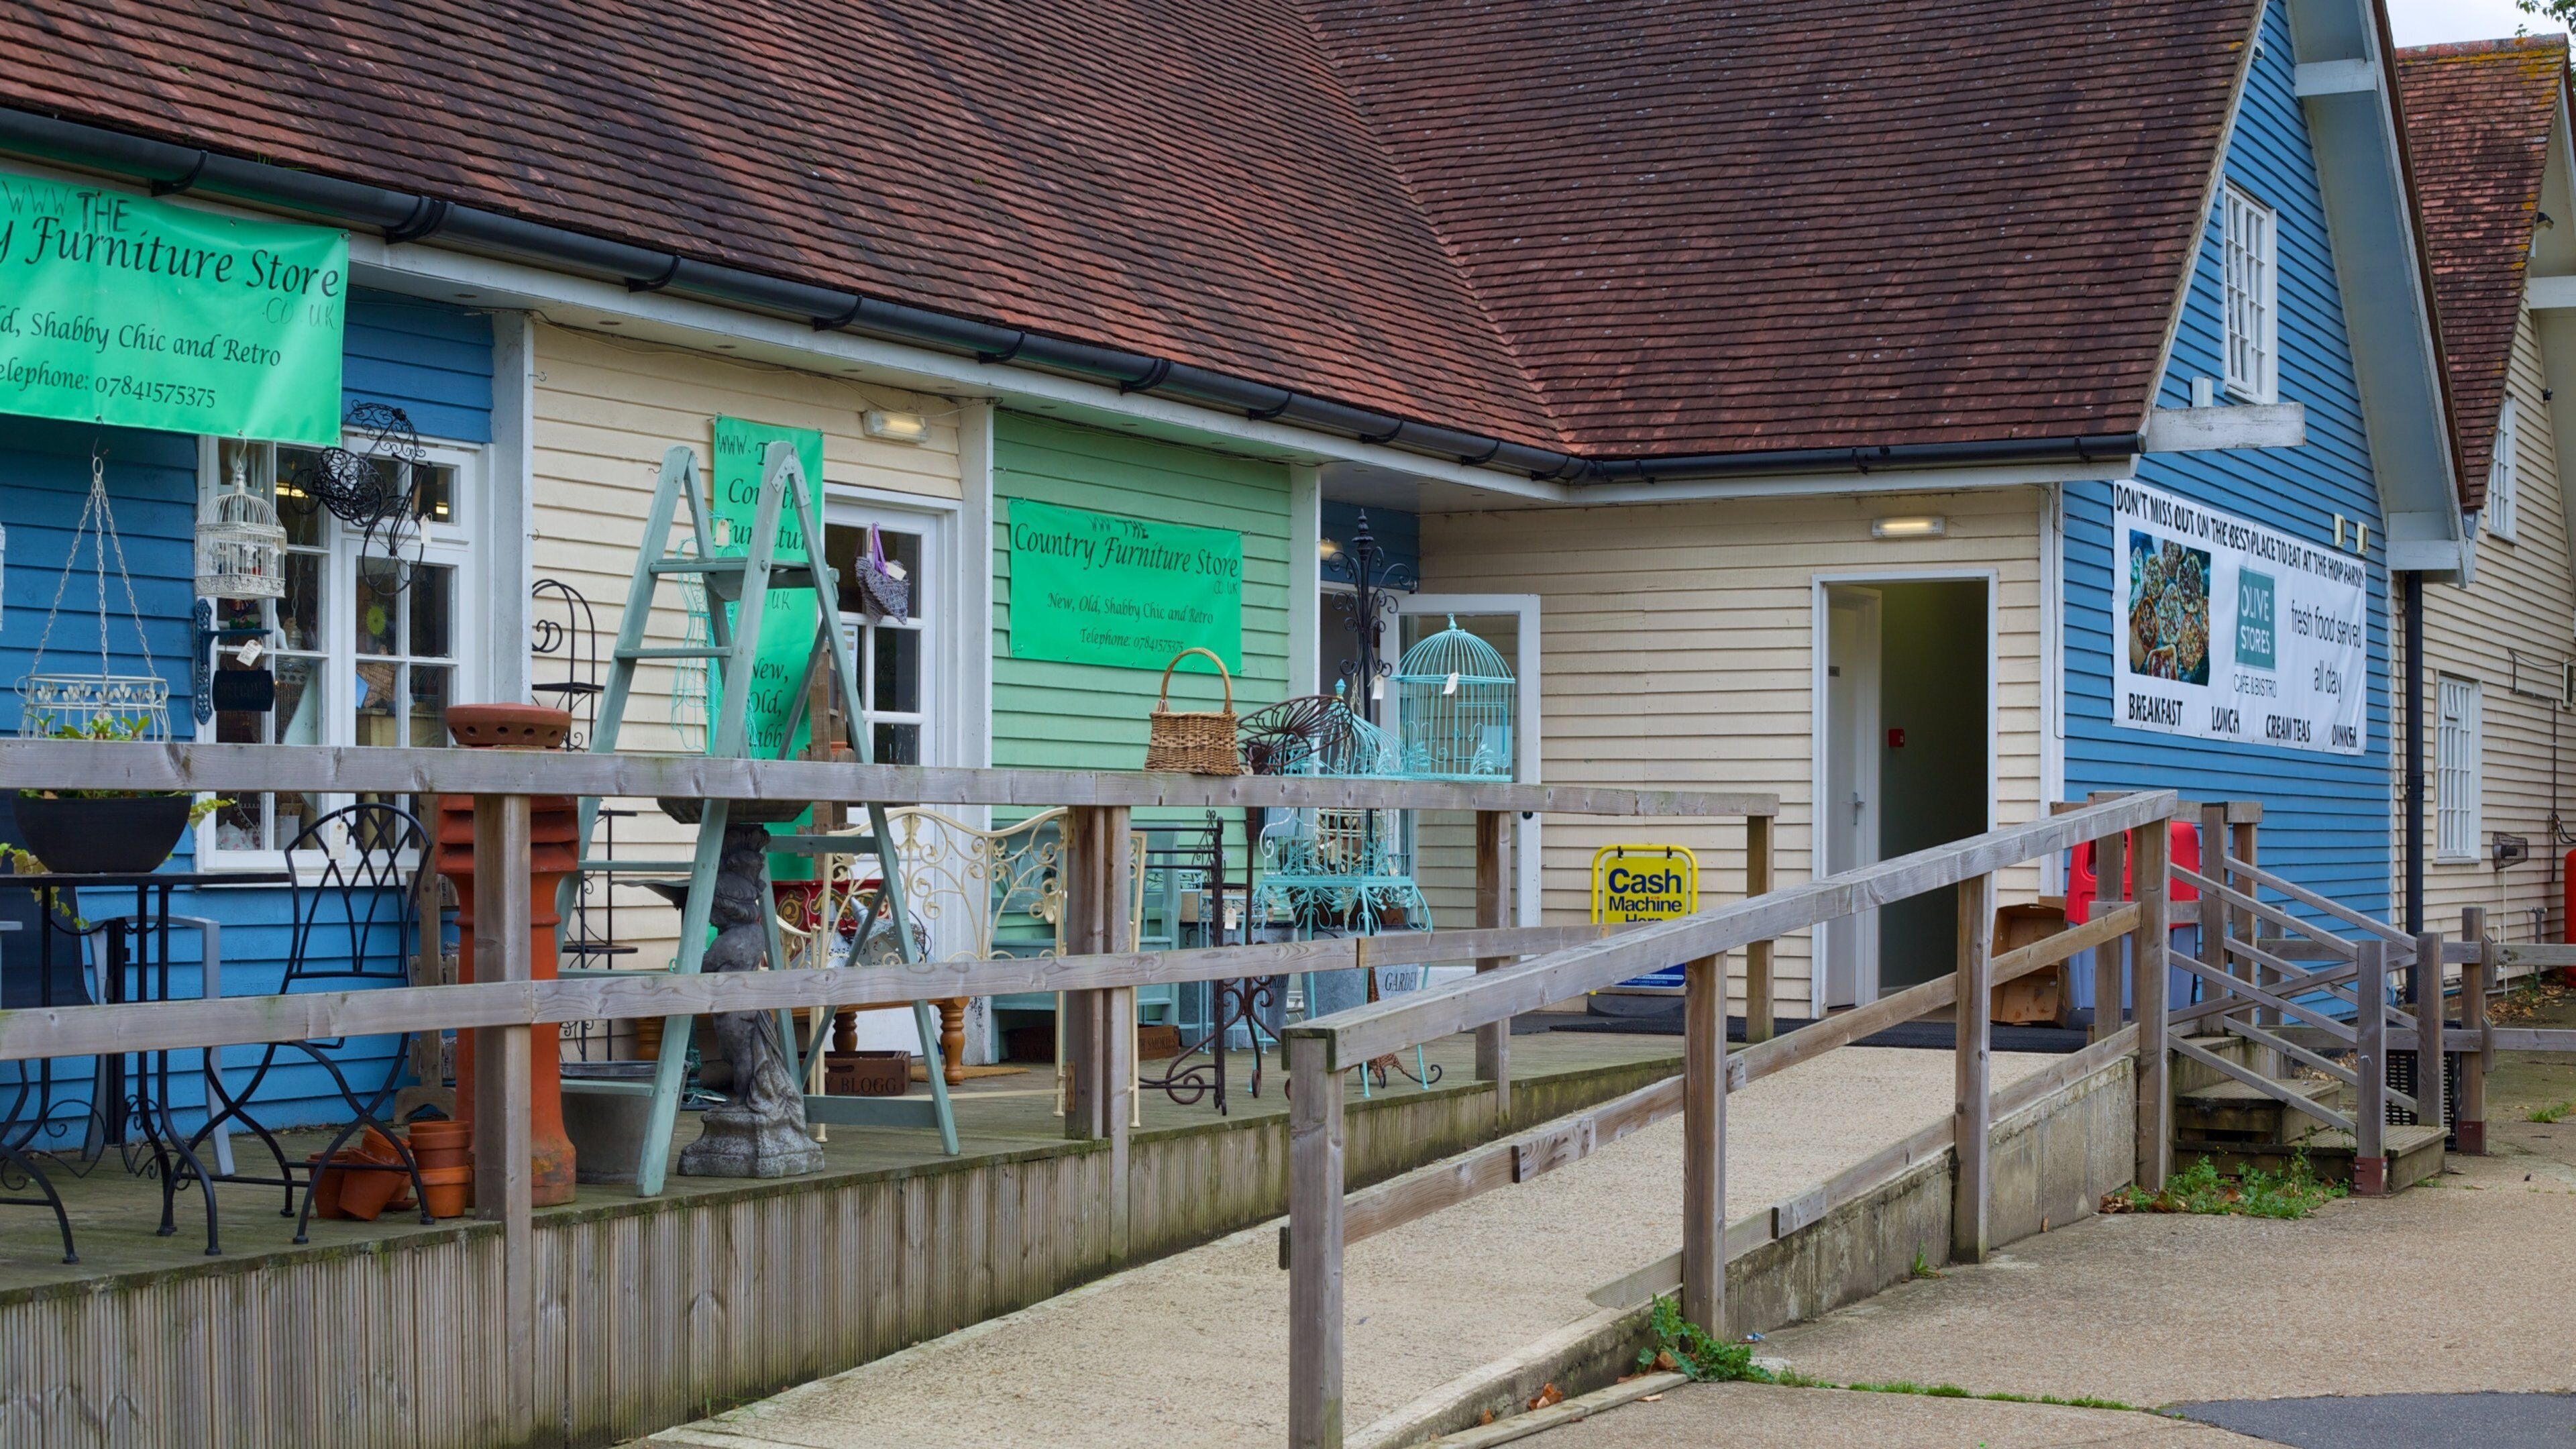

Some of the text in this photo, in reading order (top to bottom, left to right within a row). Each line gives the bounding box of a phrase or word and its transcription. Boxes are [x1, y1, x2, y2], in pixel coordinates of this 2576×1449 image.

[76, 192, 131, 233] THE
[25, 216, 233, 282] Furniture
[246, 249, 339, 297] Store
[31, 311, 109, 354] Shabby
[119, 325, 166, 352] Chic
[173, 334, 220, 360] and
[223, 339, 281, 366] Retro
[0, 358, 216, 408] elephone: 07841575375
[1115, 519, 1149, 539] THE
[2116, 484, 2148, 520] DON'T
[2150, 496, 2172, 527] MISS
[2175, 505, 2194, 535] OUT
[2197, 512, 2210, 540] ON
[2211, 517, 2227, 547] THE
[2229, 525, 2250, 552] BEST
[2251, 531, 2275, 561] PLACE
[2276, 539, 2287, 565] TO
[2288, 544, 2301, 570] EAT
[2303, 550, 2312, 572] AT
[2313, 552, 2327, 578] THE
[2328, 558, 2343, 584] HOP
[1015, 523, 1238, 577] Country Furniture Store
[1048, 593, 1214, 625] New, Old, Shabby Chic and Retro
[2241, 584, 2269, 622] OLIVE
[1080, 628, 1184, 654] Telephone: 07841575375
[2241, 624, 2270, 655] STORES
[2292, 600, 2361, 649] fresh food served
[2234, 674, 2249, 694] CAFE
[2314, 660, 2342, 703] all day
[2129, 693, 2357, 748] BREAKFAST LUNCH CREAM TEAS DINNER
[1609, 868, 1682, 894] Cash
[1609, 896, 1682, 912] Machine
[841, 1077, 897, 1093] BLOGG
